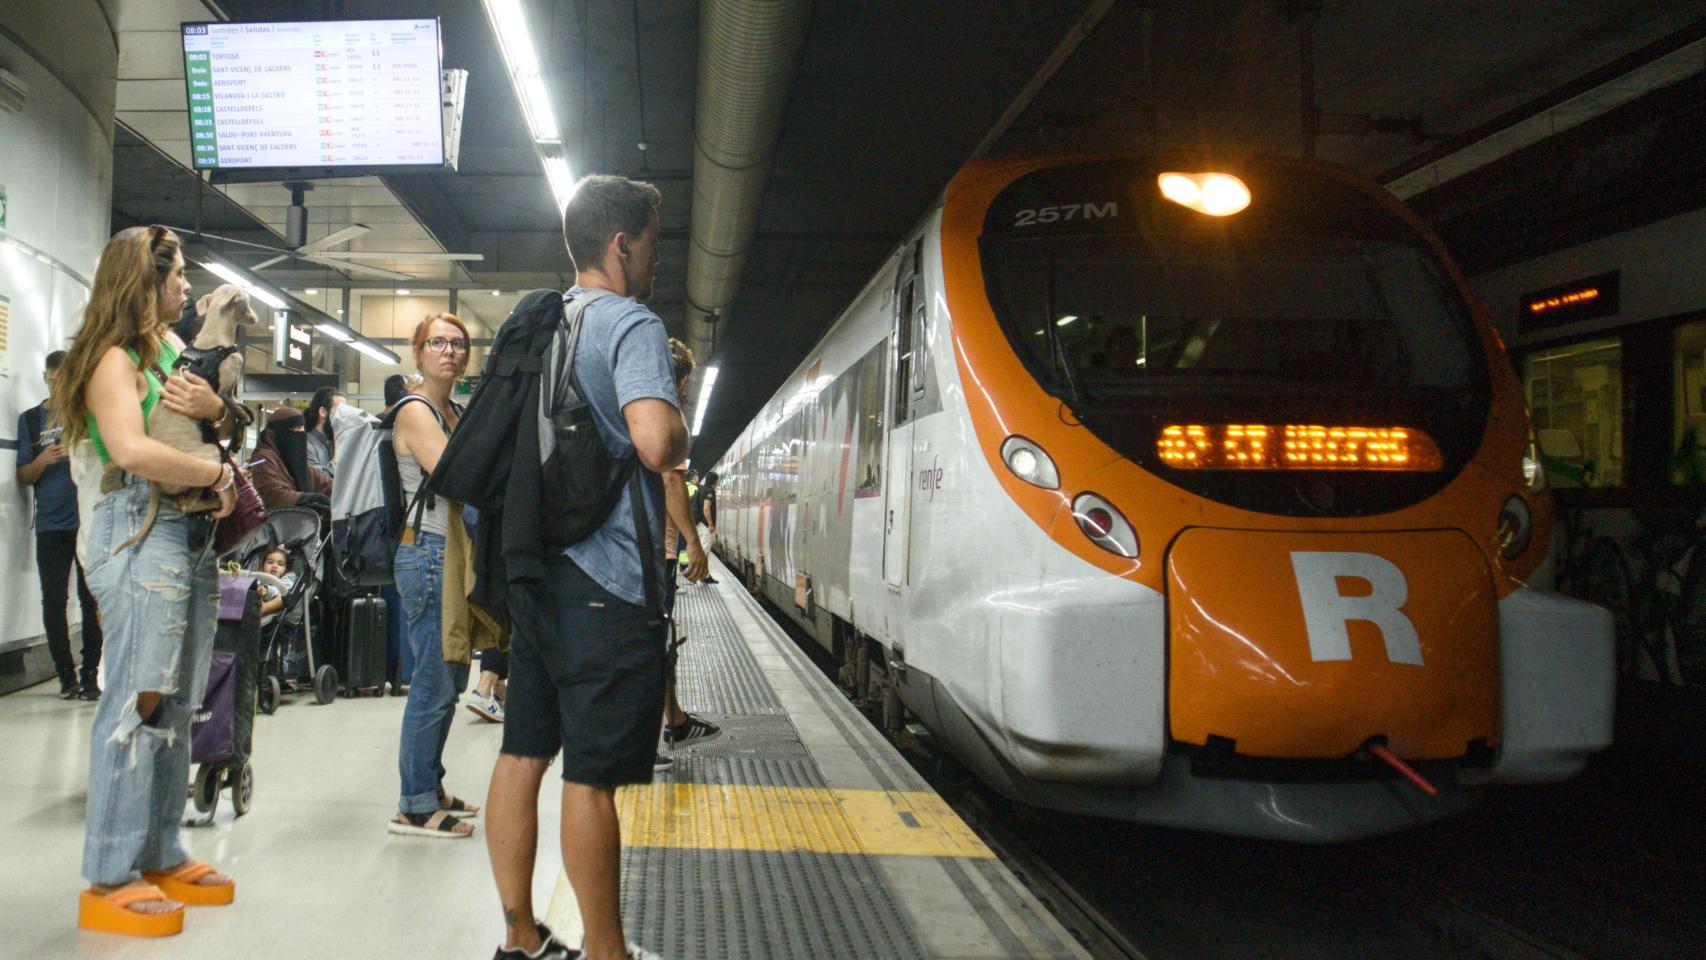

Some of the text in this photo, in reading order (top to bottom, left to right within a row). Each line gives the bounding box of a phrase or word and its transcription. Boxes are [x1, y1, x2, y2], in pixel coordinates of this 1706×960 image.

[211, 26, 239, 34] Sortides
[217, 118, 264, 126] CASTELLDEFELS
[260, 143, 268, 151] DE
[270, 143, 297, 151] CALDERS
[1014, 202, 1119, 227] 257M
[918, 454, 943, 503] renfe
[1289, 551, 1425, 666] R
